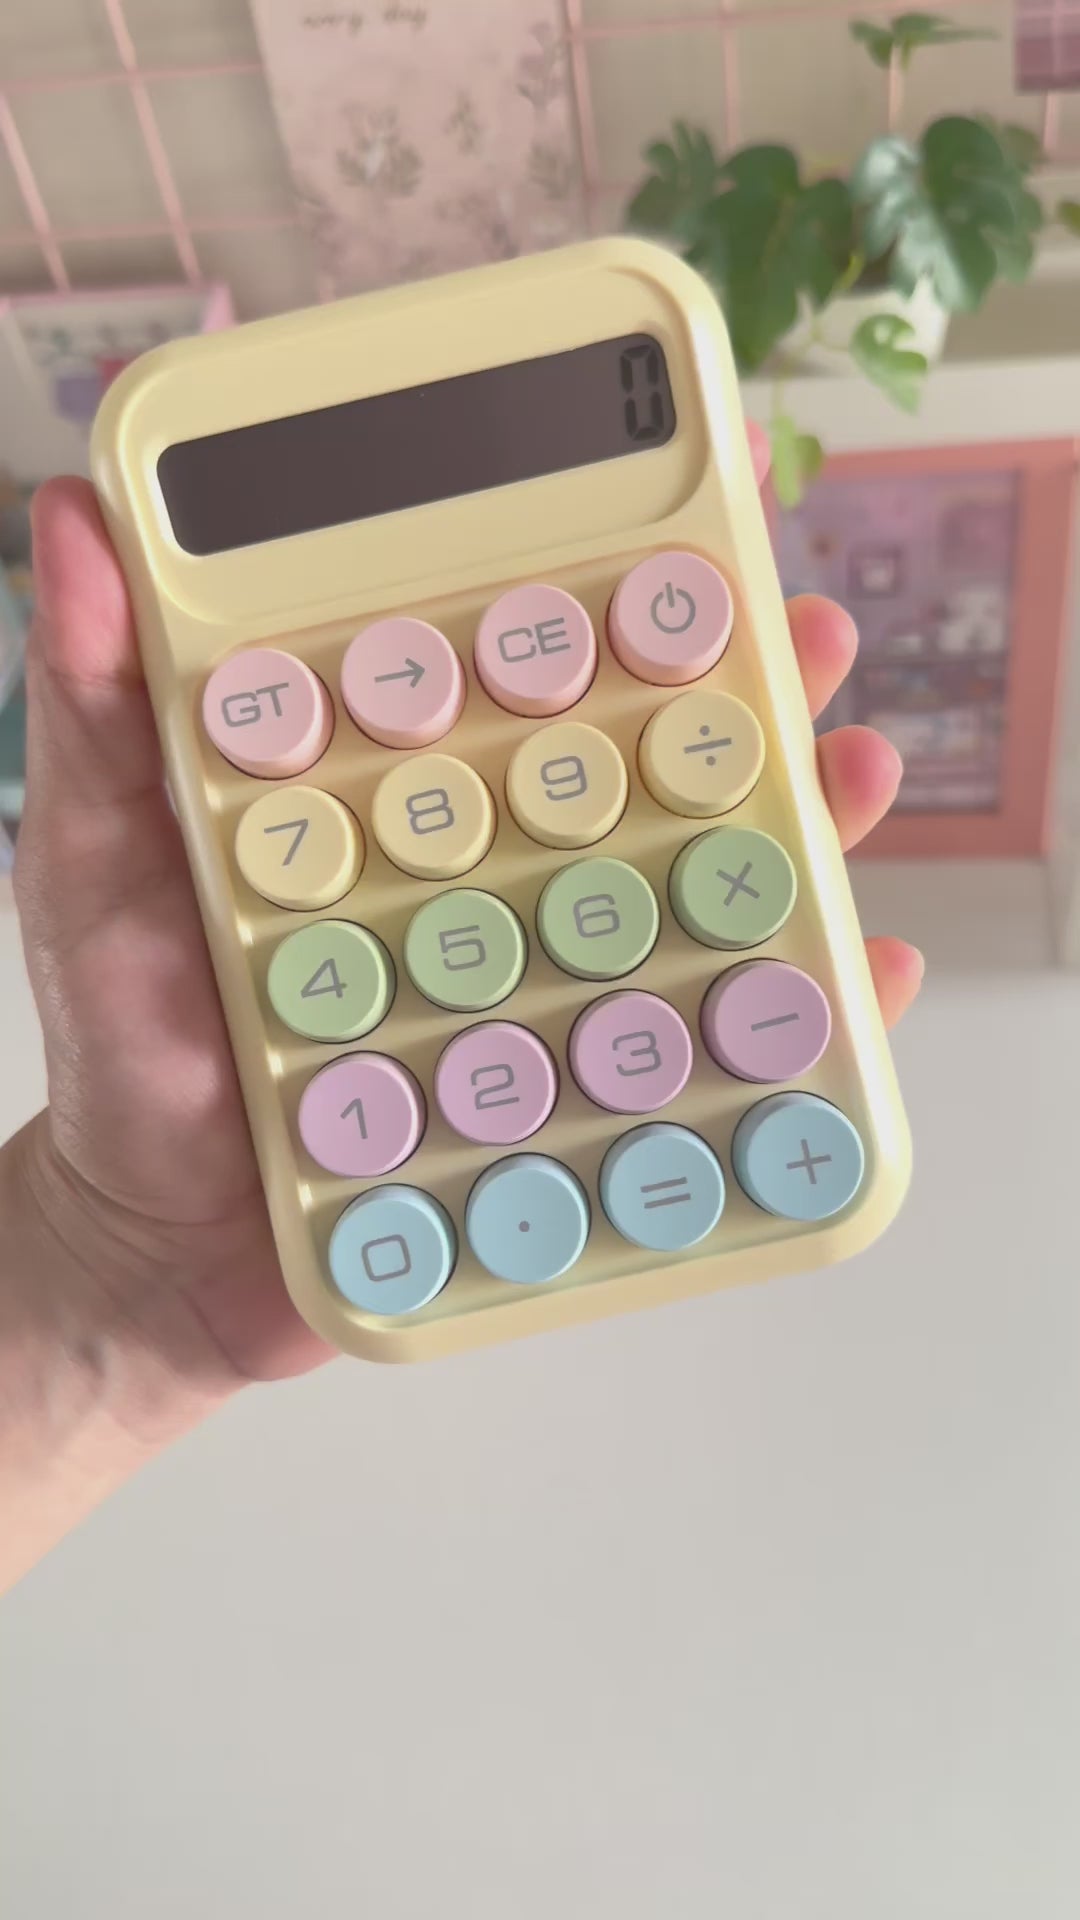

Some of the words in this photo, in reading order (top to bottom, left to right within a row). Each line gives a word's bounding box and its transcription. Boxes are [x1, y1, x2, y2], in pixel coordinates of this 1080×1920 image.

[620, 344, 664, 441] 0
[498, 617, 571, 664] CE
[220, 682, 290, 728] GT
[539, 755, 588, 801] 9
[405, 788, 455, 835] 8
[263, 818, 309, 865] 7
[573, 893, 620, 939] 6
[438, 924, 487, 971] 5
[300, 958, 347, 999] 4
[611, 1030, 662, 1077] 3
[470, 1062, 520, 1110] 2
[340, 1097, 369, 1140] 1
[786, 1138, 832, 1185] +
[361, 1233, 412, 1282] 0
